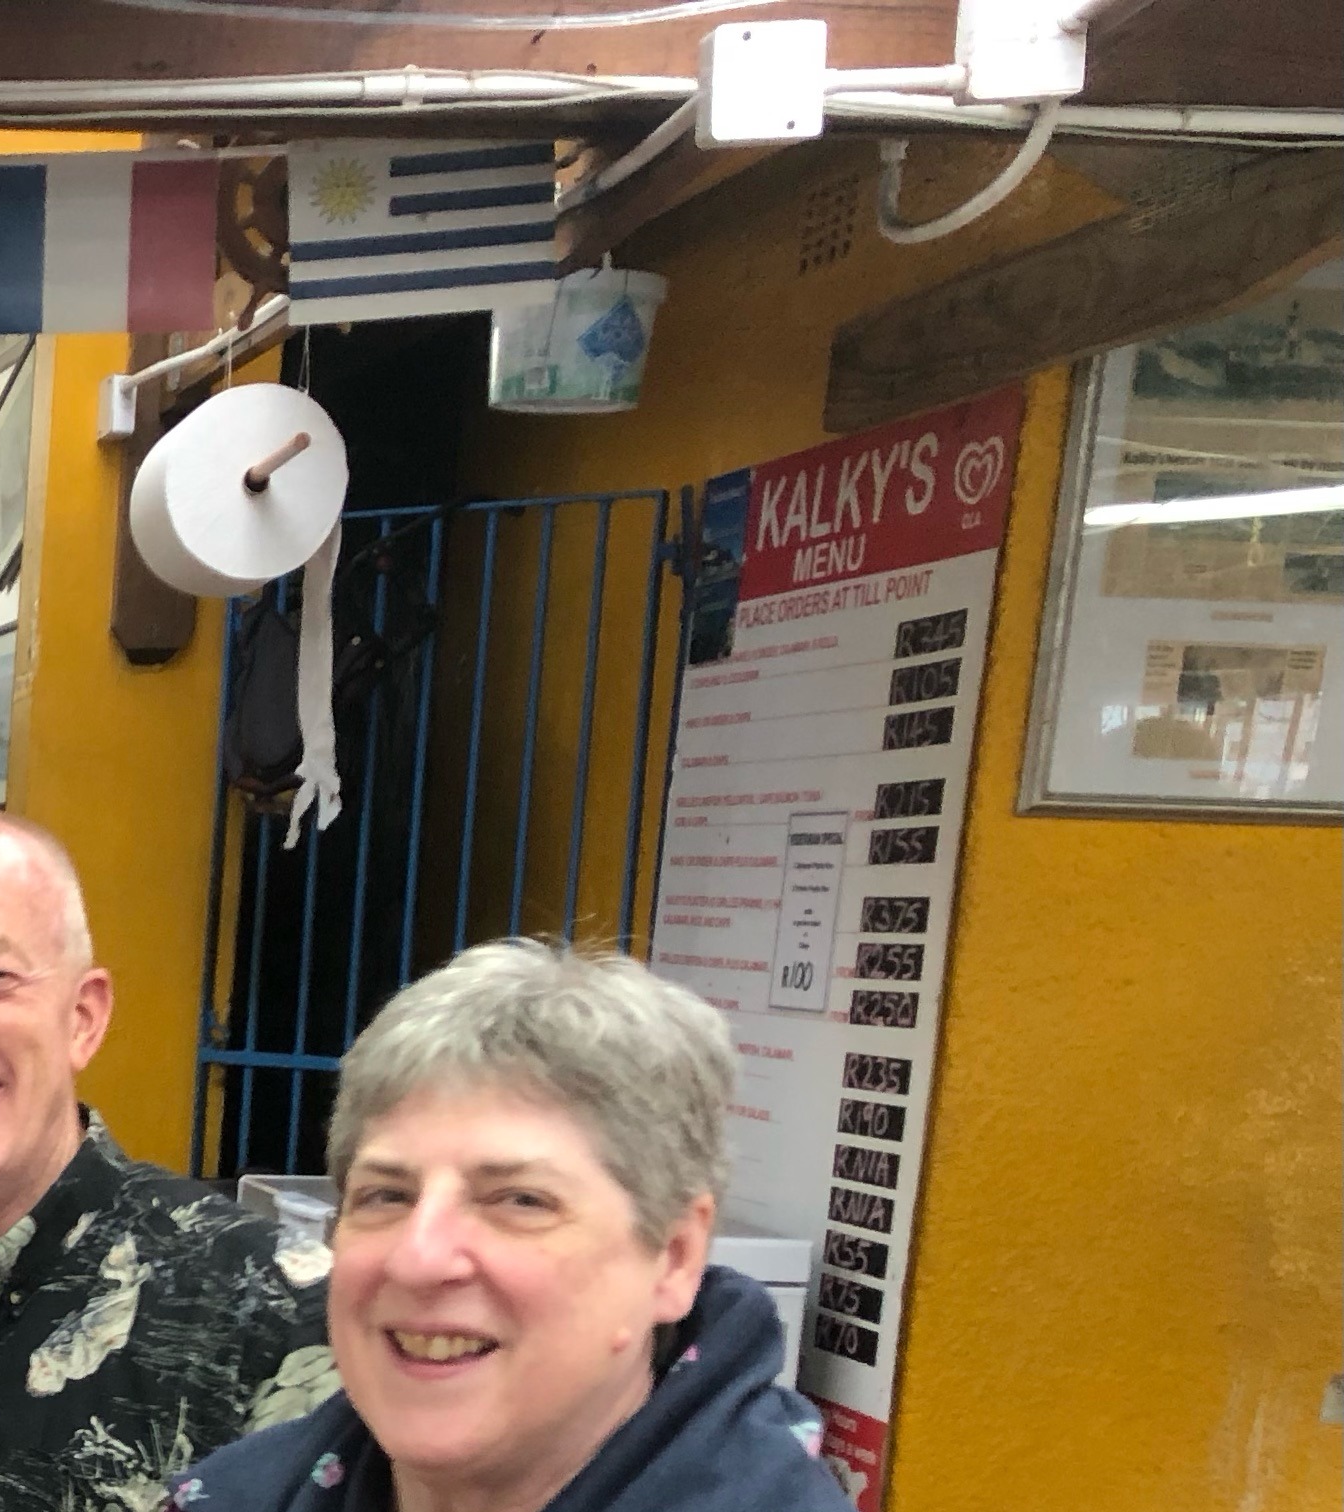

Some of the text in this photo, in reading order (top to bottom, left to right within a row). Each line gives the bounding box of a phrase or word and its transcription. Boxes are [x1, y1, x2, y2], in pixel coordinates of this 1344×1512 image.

[756, 431, 939, 552] KALKY'S
[792, 533, 867, 583] MENU
[739, 569, 934, 629] PLACE ORDERS AT TILL POINT
[844, 1054, 901, 1093] R235
[840, 1099, 889, 1136] R190
